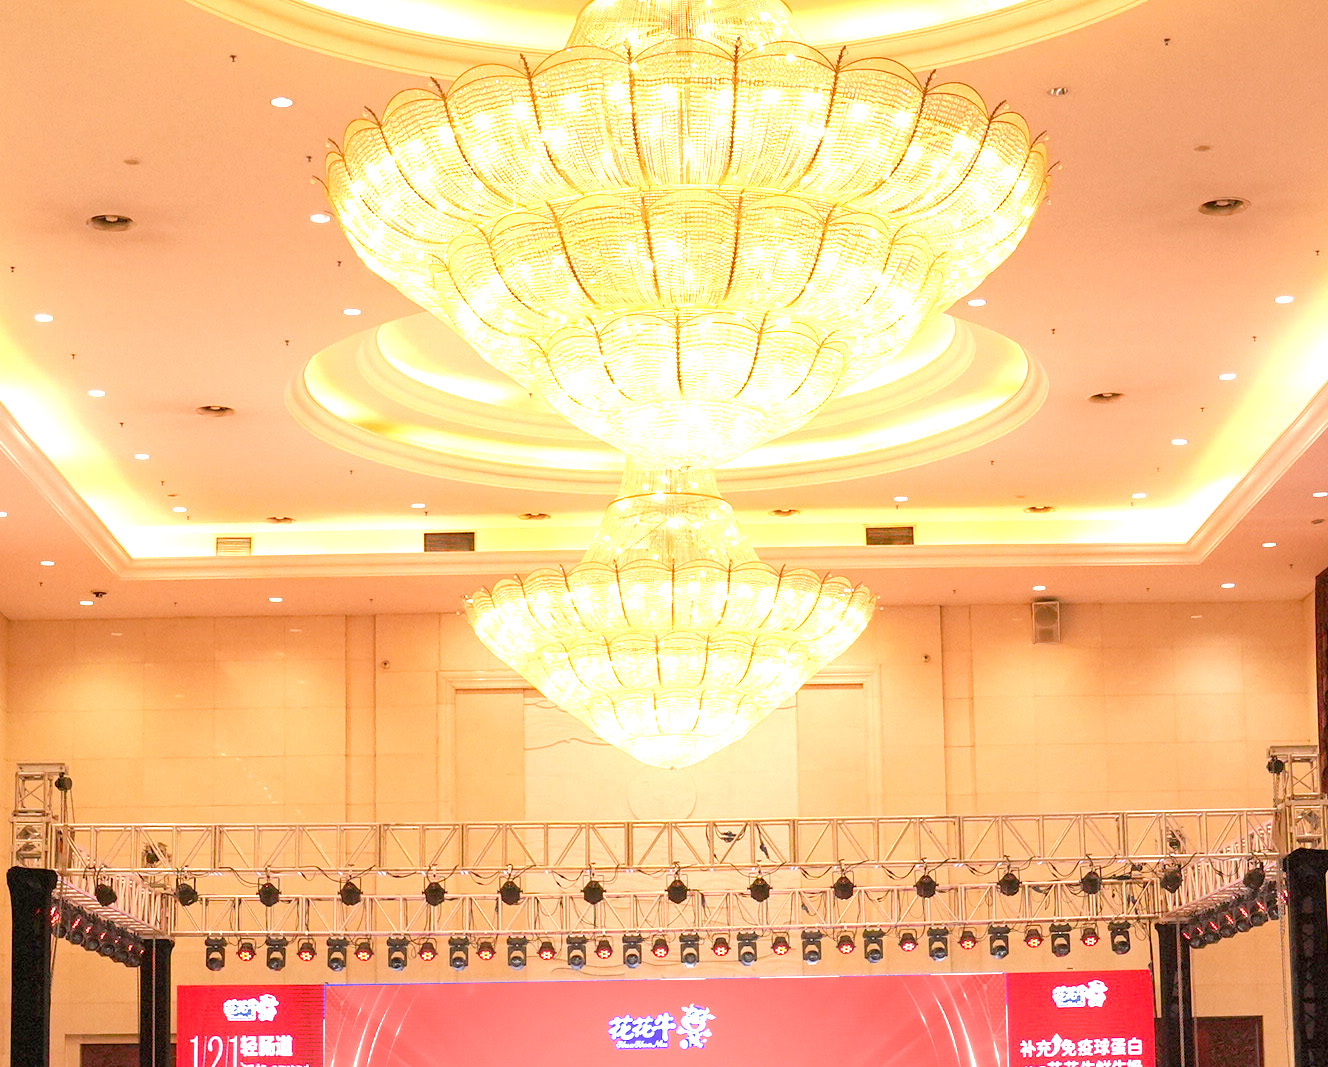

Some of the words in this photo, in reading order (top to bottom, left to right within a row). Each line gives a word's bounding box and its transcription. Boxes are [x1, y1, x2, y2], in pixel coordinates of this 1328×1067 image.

[608, 1013, 676, 1041] 花花牛
[1019, 1036, 1143, 1057] 补充免疫球蛋白
